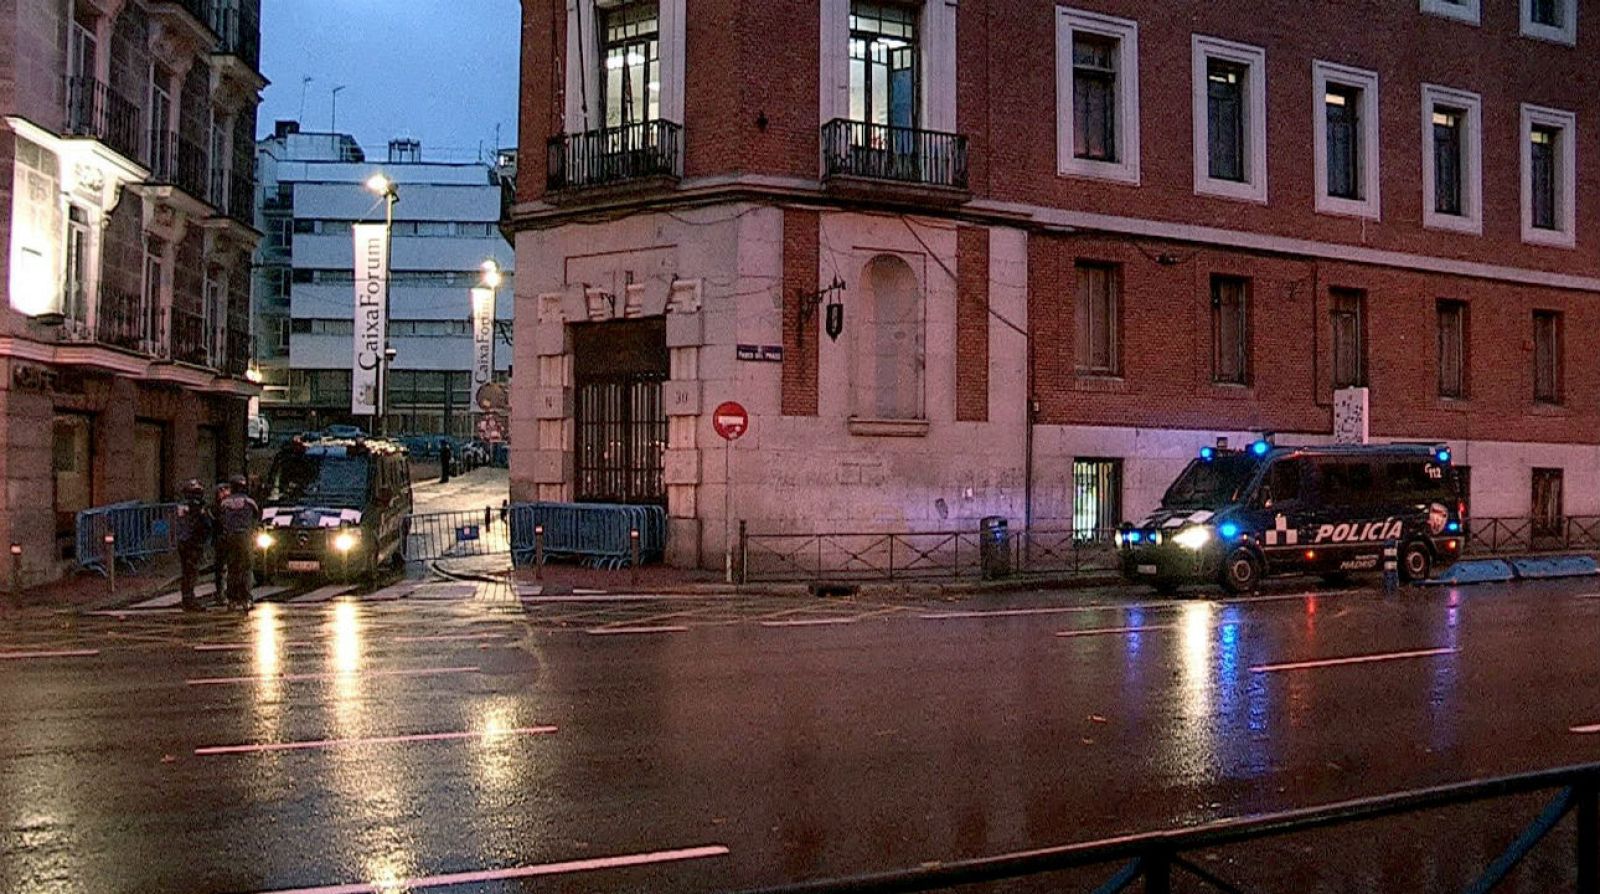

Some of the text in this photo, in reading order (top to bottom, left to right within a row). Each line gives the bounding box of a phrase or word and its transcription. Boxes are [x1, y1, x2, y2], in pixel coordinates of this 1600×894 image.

[358, 237, 381, 371] CaixaForum
[475, 298, 490, 383] CaixaForum
[1429, 467, 1442, 478] 112
[1315, 517, 1403, 543] POLICÍA
